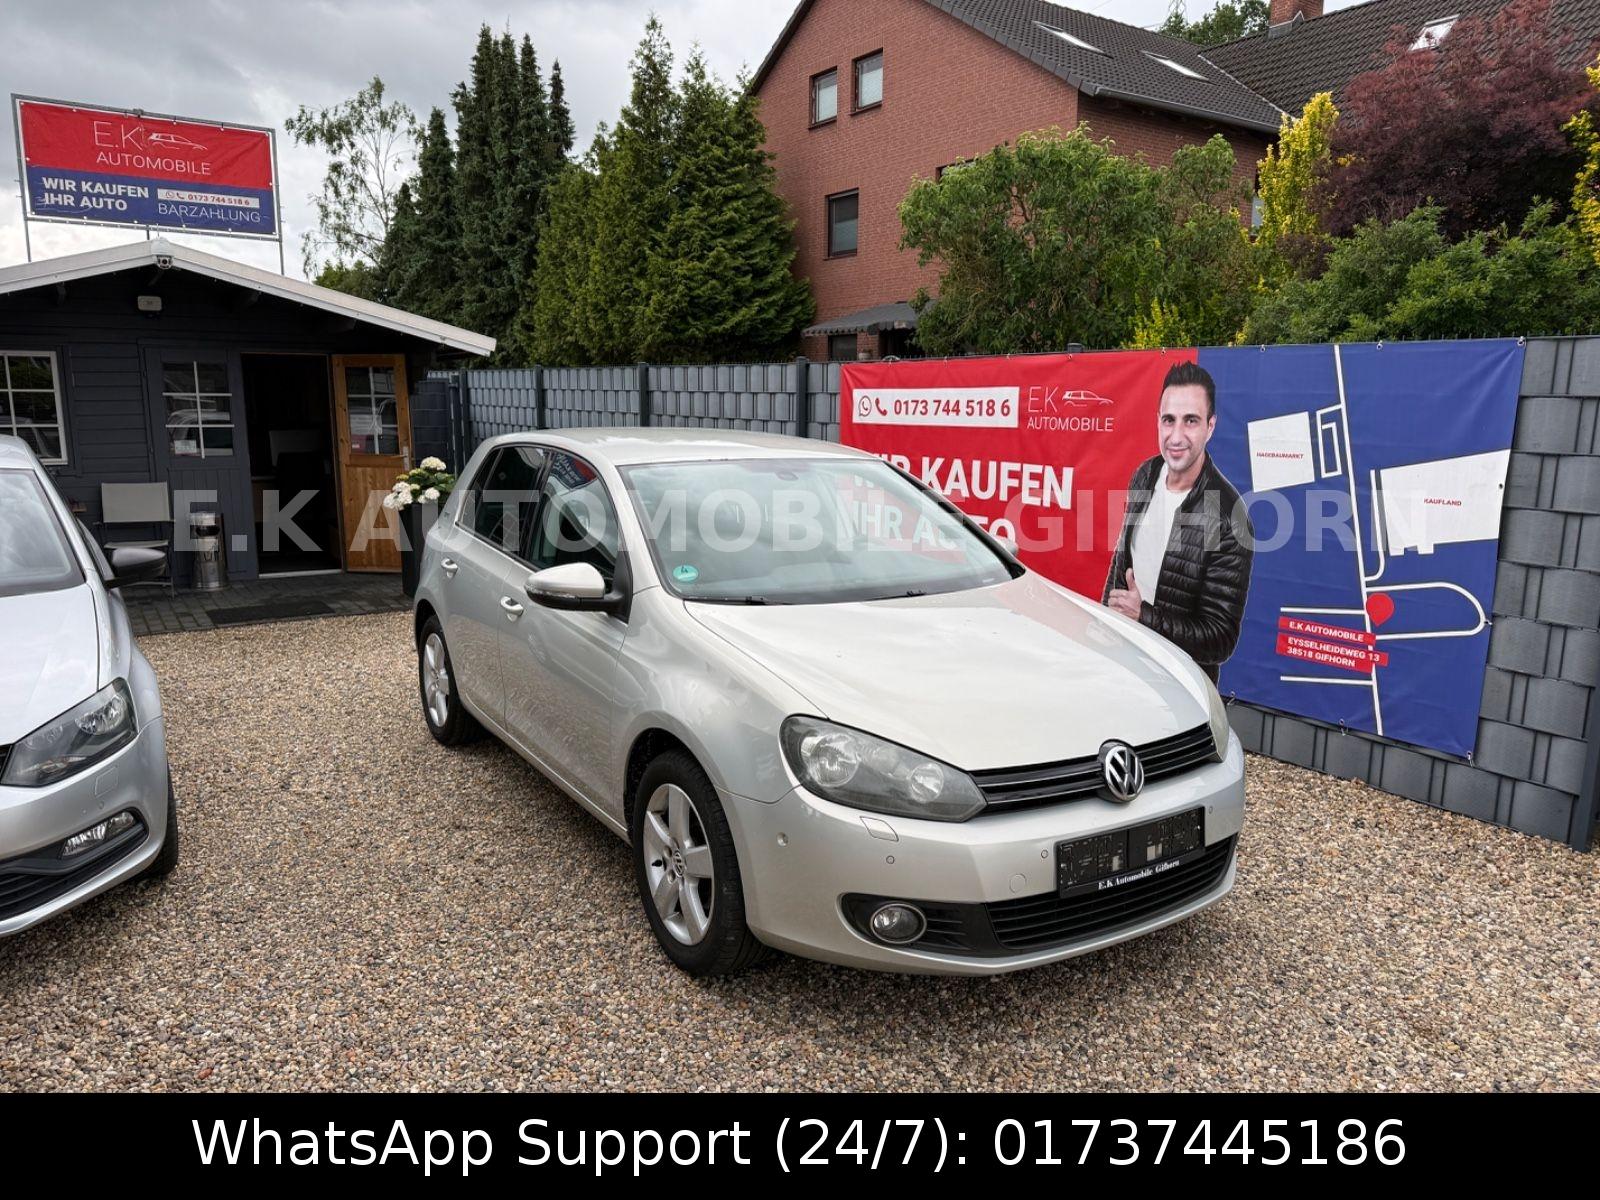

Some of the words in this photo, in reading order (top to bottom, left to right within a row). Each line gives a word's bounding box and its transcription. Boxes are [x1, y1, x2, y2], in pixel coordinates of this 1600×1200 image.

[93, 121, 143, 151] E.K
[96, 151, 212, 176] AUTOMOBILE
[42, 177, 77, 191] WIR
[81, 181, 149, 198] KAUFEN
[44, 193, 76, 206] IHR
[80, 196, 128, 211] AUTO
[188, 193, 208, 202] 0173
[211, 196, 226, 204] 744
[158, 203, 261, 222] BARZAHLUNG
[893, 399, 929, 416] 0173
[932, 400, 961, 416] 744
[965, 400, 996, 417] 518
[1000, 399, 1011, 417] 6
[1027, 386, 1059, 413] E.K
[1027, 416, 1114, 432] AUTOMOBILE
[921, 456, 1075, 510] KAUFEN
[1423, 498, 1462, 506] KAUFLAND
[1289, 621, 1304, 631] E.K
[1305, 624, 1365, 642] AUTOMOBILE
[1287, 636, 1366, 659] EYSSELHEIDEWEG
[1367, 653, 1380, 662] 13
[1287, 646, 1313, 658] 38518
[1315, 652, 1356, 667] GIFHORN
[1098, 879, 1113, 890] E.K
[1115, 868, 1154, 886] Automobile
[1155, 859, 1180, 873] Gifhorn
